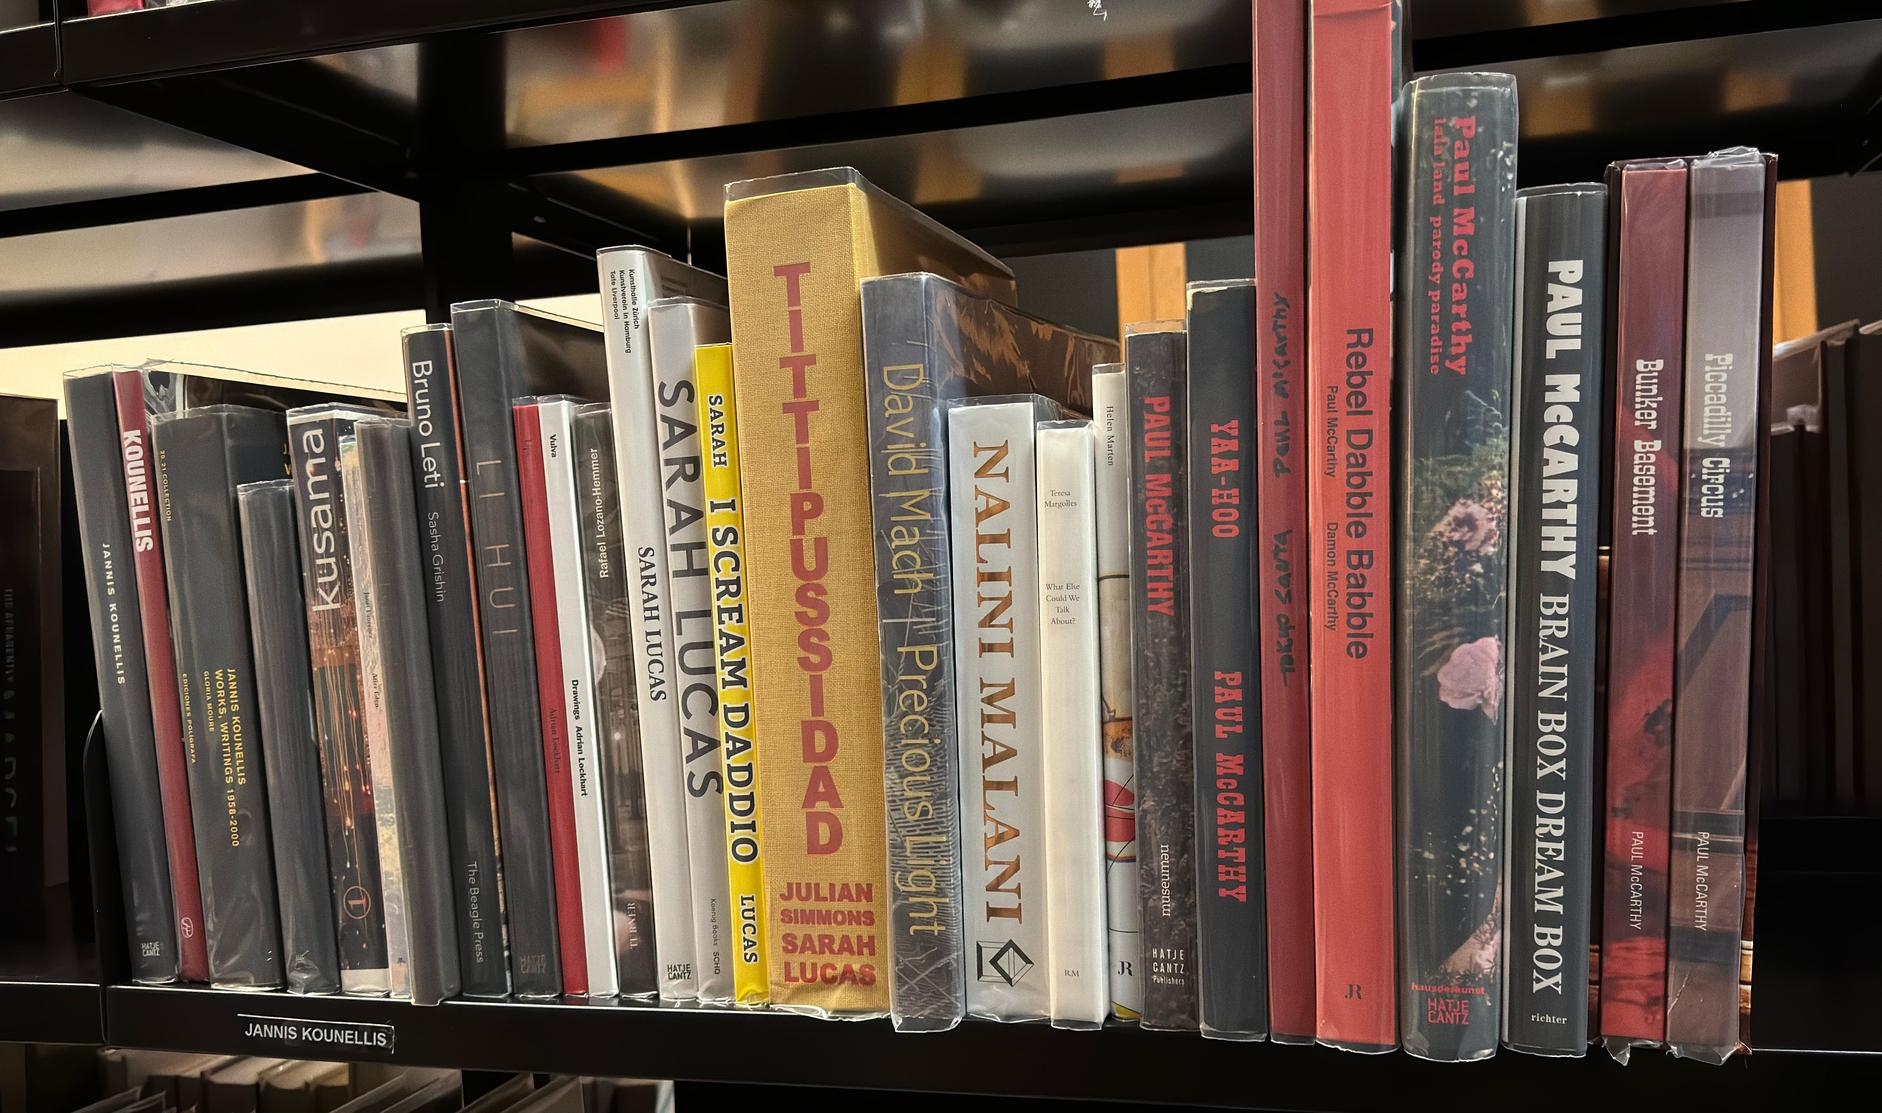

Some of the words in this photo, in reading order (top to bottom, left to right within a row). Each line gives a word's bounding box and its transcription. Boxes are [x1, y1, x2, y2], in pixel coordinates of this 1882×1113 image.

[1432, 162, 1446, 206] land
[1452, 116, 1476, 196] Paul
[1429, 215, 1444, 284] parody
[612, 288, 620, 320] Liverpool
[618, 270, 628, 310] Kunstverein
[624, 321, 632, 354] Hamburg
[628, 268, 638, 306] Kunsthalle
[1444, 207, 1476, 375] McCarthy
[1545, 260, 1584, 360] PAUL
[632, 308, 640, 330] Zürich
[1428, 290, 1443, 375] paradise
[412, 360, 434, 435] Bruno
[1327, 385, 1338, 414] Paul
[1345, 328, 1374, 416] Rebel
[1634, 359, 1664, 430] Bunker
[1697, 353, 1734, 448] Piccadilly
[550, 434, 558, 458] Vulva
[708, 394, 728, 468] SARAH
[882, 363, 928, 476] David
[1144, 396, 1174, 463] PAUL
[1324, 416, 1338, 478] McCarthy
[420, 442, 445, 490] Leti
[658, 379, 709, 578] SARAH
[1106, 434, 1114, 467] Marten
[1210, 418, 1241, 539] YAA-HOO
[1540, 374, 1580, 580] McCARTHY
[123, 429, 154, 554] KOUNELLIS
[162, 474, 172, 522] COLLECTION
[590, 448, 606, 538] Lozano-Hemmer
[709, 499, 736, 513] I
[1044, 499, 1078, 508] Margolles
[1050, 489, 1070, 497] Teresa
[1345, 429, 1374, 540] Dabble
[1632, 440, 1662, 536] Basement
[1700, 458, 1730, 518] Circus
[302, 428, 341, 614] kusama
[428, 511, 440, 552] Sasha
[886, 490, 928, 594] Mach
[973, 440, 1014, 658] NALINI
[1144, 473, 1175, 618] McCARTHY
[1327, 522, 1338, 566] Damon
[432, 553, 445, 603] Grishin
[598, 542, 608, 578] Rafael
[638, 546, 660, 623] SARAH
[773, 262, 844, 856] TITTIPUSSIDAD
[1045, 582, 1064, 591] What
[1065, 582, 1080, 591] Else
[102, 543, 116, 596] JANNIS
[109, 602, 126, 685] KOUNELLIS
[712, 526, 748, 690] SCREAM
[1045, 594, 1064, 602] Could
[1066, 594, 1080, 602] We
[1050, 617, 1076, 625] About?
[1055, 606, 1070, 614] Talk
[1324, 570, 1338, 632] McCarthy
[1345, 550, 1374, 659] Babble
[644, 629, 667, 702] LUCAS
[1538, 592, 1570, 702] BRAIN
[182, 673, 192, 716] EDICIONES
[203, 670, 212, 701] GLORIA
[214, 669, 227, 719] WORKS,
[227, 668, 240, 712] JANNIS
[571, 679, 582, 720] Drawings
[675, 610, 724, 798] LUCAS
[1214, 670, 1244, 740] PAUL
[206, 703, 214, 733] MOURE
[575, 726, 583, 755] Adrian
[896, 644, 942, 820] Precious
[1536, 710, 1568, 781] BOX
[220, 722, 235, 784] WRITINGS
[232, 716, 247, 786] KOUNELLIS
[578, 757, 588, 798] Lockhart
[722, 703, 758, 863] DADDIO
[979, 676, 1024, 926] MALANI
[226, 788, 240, 847] 1958-2000
[1214, 754, 1247, 903] McCARTHY
[1631, 831, 1644, 861] PAUL
[1696, 831, 1710, 862] PAUL
[466, 860, 479, 884] The
[1534, 791, 1567, 915] DREAM
[468, 887, 483, 929] Beagle
[780, 882, 873, 902] JULIAN
[894, 834, 950, 937] Light
[1630, 864, 1643, 930] McCARTHY
[1694, 865, 1709, 931] McCARTHY
[474, 932, 484, 963] Press
[712, 924, 720, 946] Books
[740, 894, 758, 964] LUCAS
[780, 908, 876, 926] SIMMONS
[782, 933, 876, 956] SARAH
[667, 963, 691, 973] HATJE
[668, 972, 692, 981] CANTZ
[784, 961, 876, 987] LUCAS
[1152, 948, 1184, 960] HATJE
[1152, 962, 1184, 974] CANTZ
[1532, 924, 1564, 995] BOX
[244, 1022, 298, 1041] JANNIS
[302, 1027, 387, 1047] KOUNELLIS
[1428, 998, 1470, 1012] HATJE
[1428, 1010, 1470, 1024] CANTZ
[1530, 1013, 1568, 1024] richter
